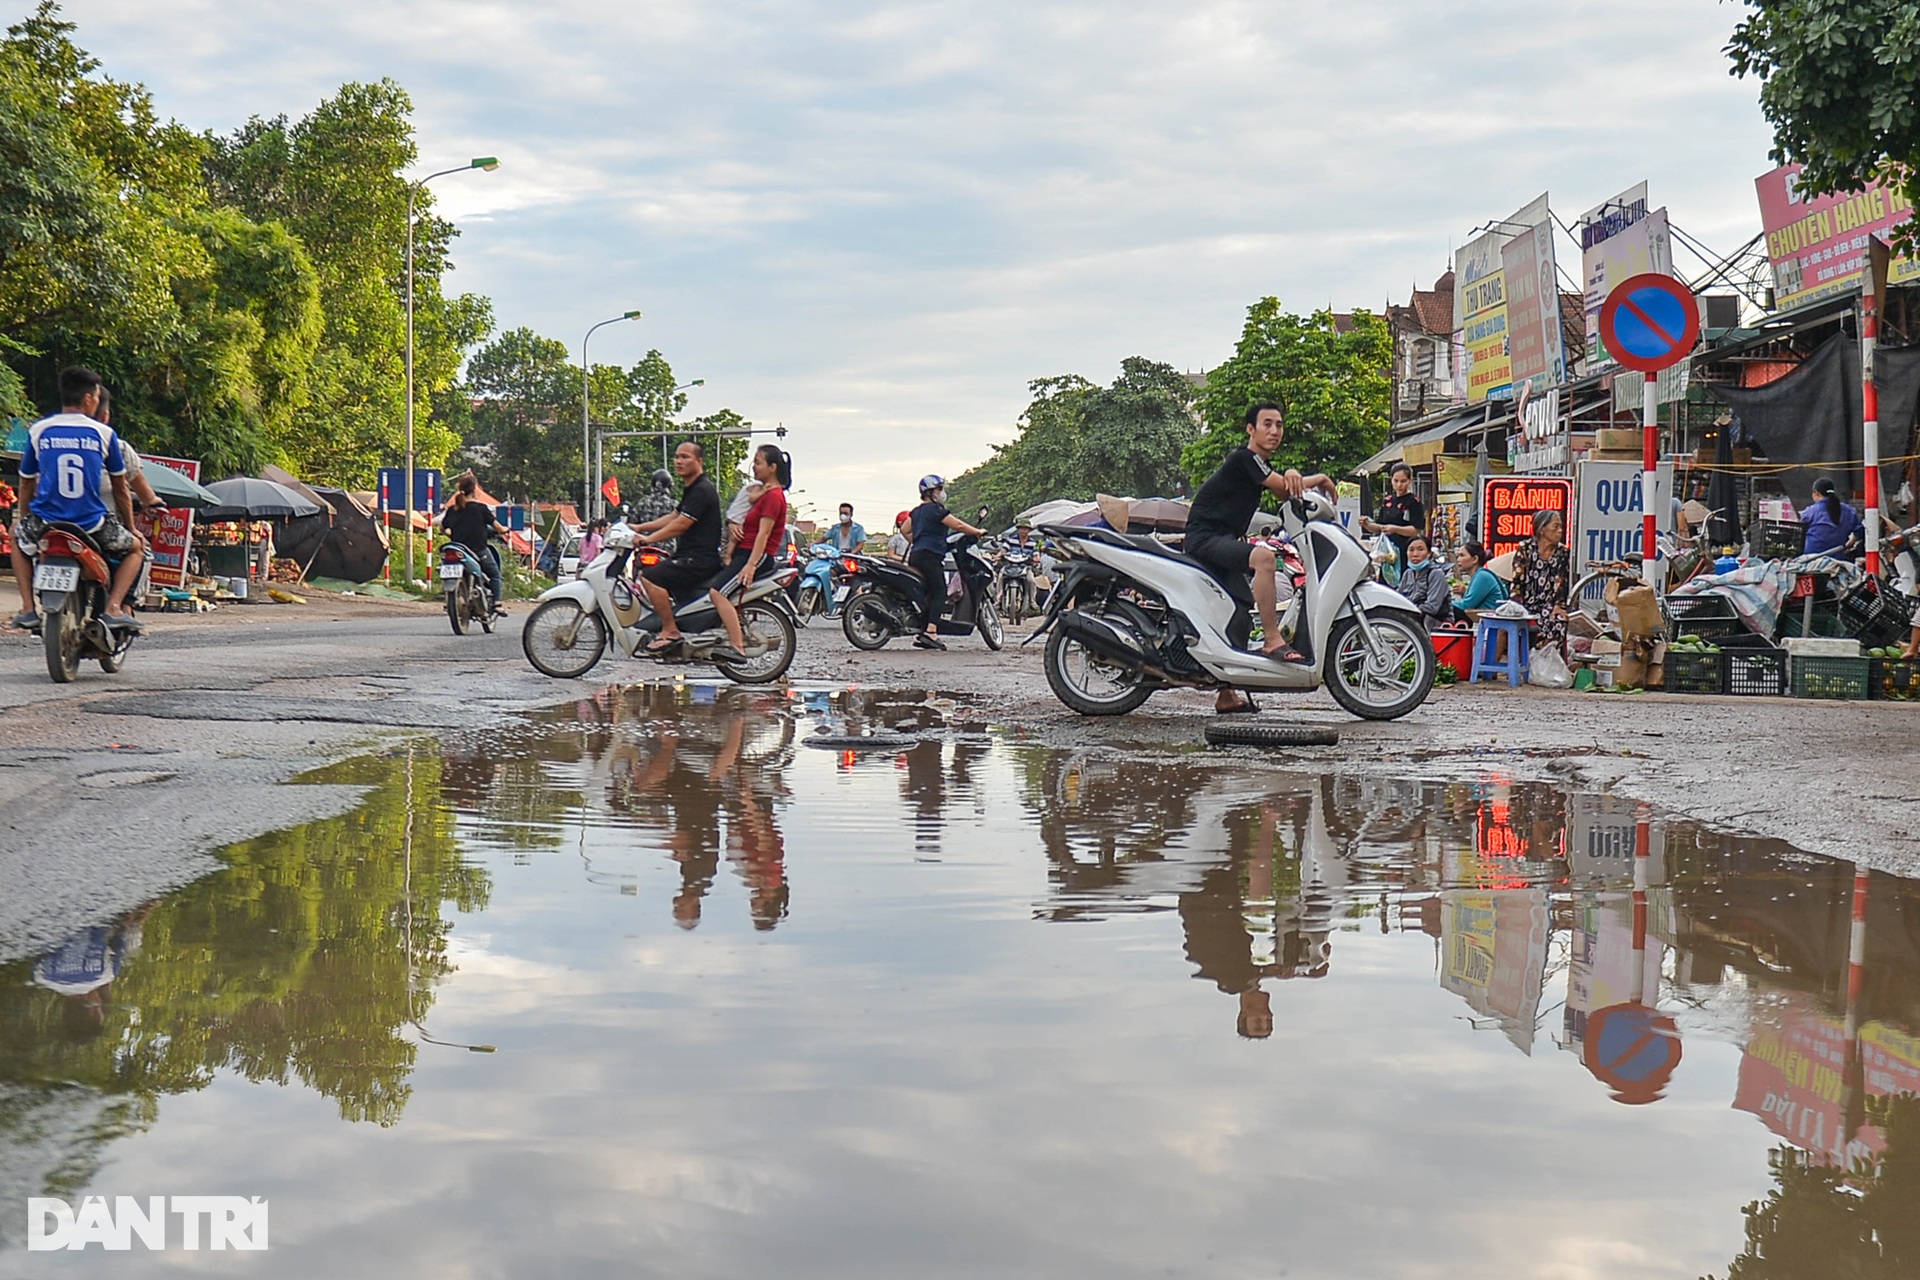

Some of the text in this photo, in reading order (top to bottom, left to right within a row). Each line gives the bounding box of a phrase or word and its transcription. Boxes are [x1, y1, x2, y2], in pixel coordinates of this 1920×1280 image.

[1768, 210, 1833, 260] CHUYÊN
[1833, 187, 1885, 235] HÀNG
[1479, 276, 1502, 310] TRANG
[50, 437, 80, 450] TRUNG
[57, 453, 85, 499] 6
[1494, 484, 1562, 510] BÁNH
[161, 515, 184, 532] Sáp
[1497, 514, 1534, 536] SIN
